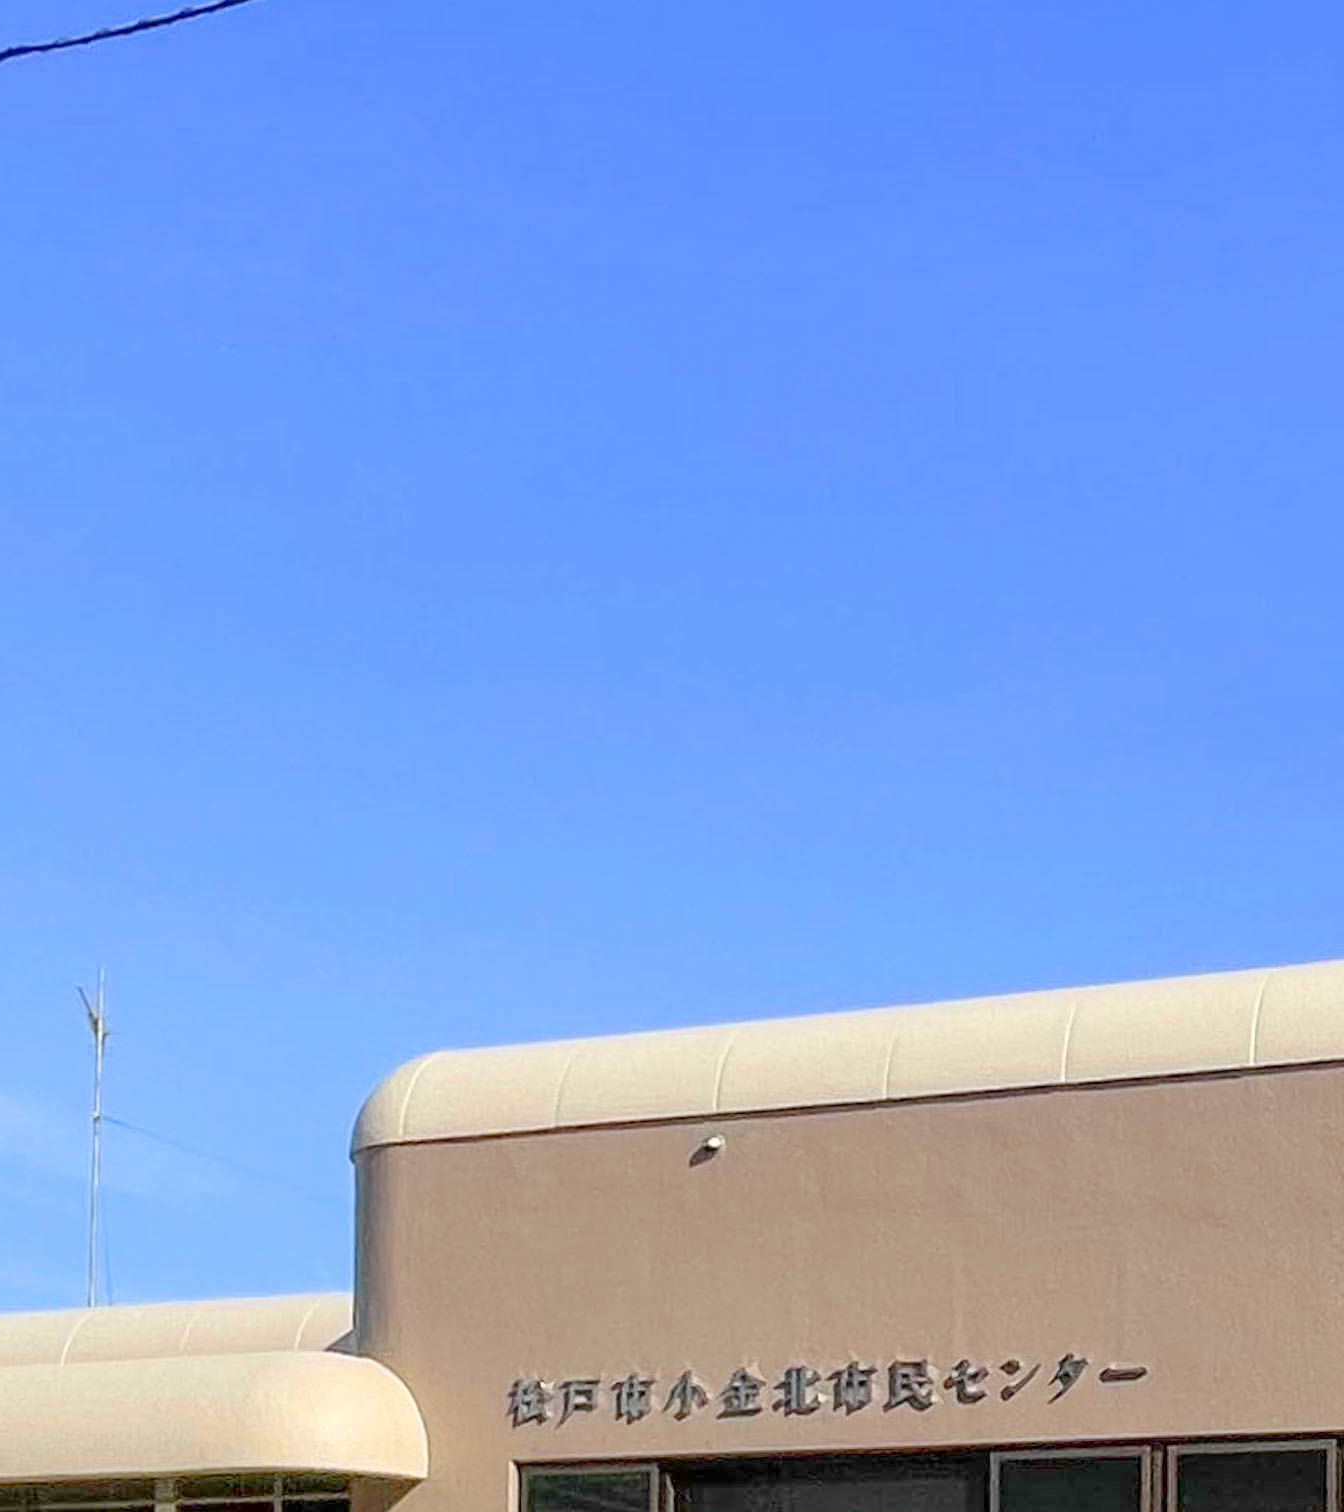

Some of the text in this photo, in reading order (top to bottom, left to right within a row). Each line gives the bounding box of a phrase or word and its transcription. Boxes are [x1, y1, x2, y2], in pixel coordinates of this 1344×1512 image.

[505, 1352, 1147, 1430] 松戸市小金北市民センター
